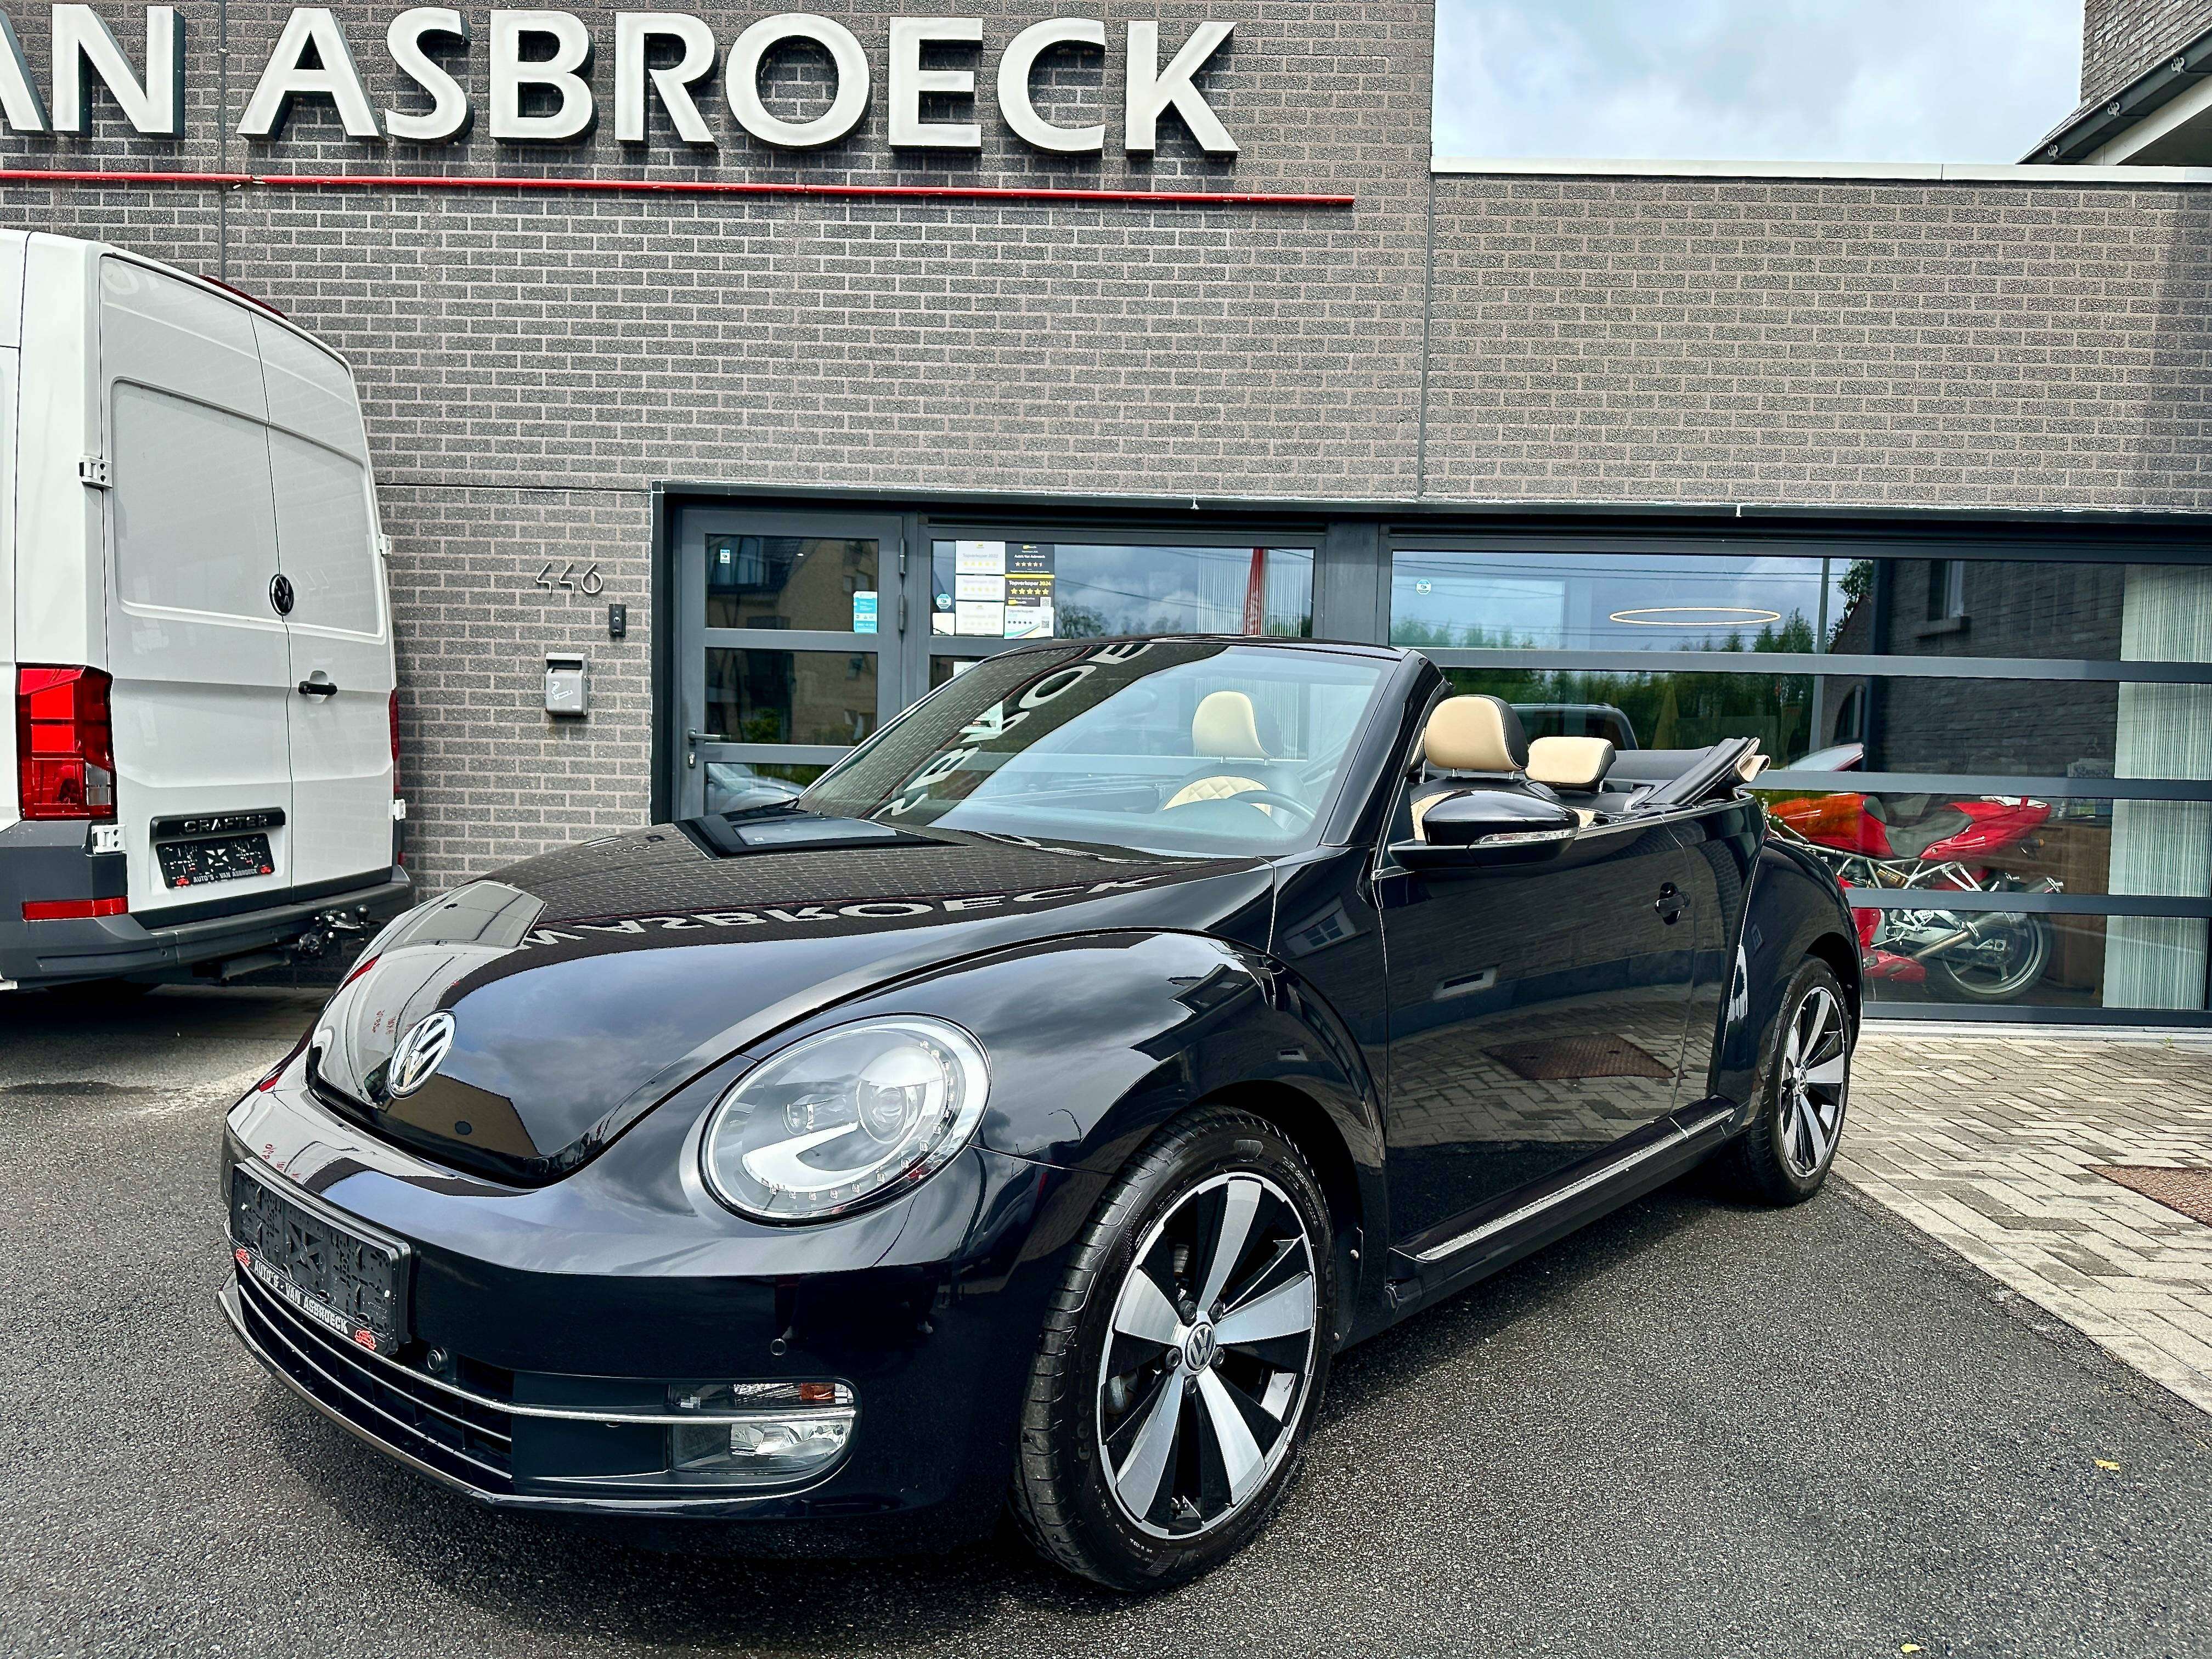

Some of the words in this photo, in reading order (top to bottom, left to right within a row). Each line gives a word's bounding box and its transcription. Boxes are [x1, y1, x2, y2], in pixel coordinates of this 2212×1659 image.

[235, 7, 1239, 157] ASBROECK
[535, 562, 603, 594] 446
[185, 815, 268, 833] CRAFTER
[253, 1261, 279, 1288] AUTO'S
[285, 1282, 301, 1305] VAN
[303, 1296, 348, 1334] ASBROECK
